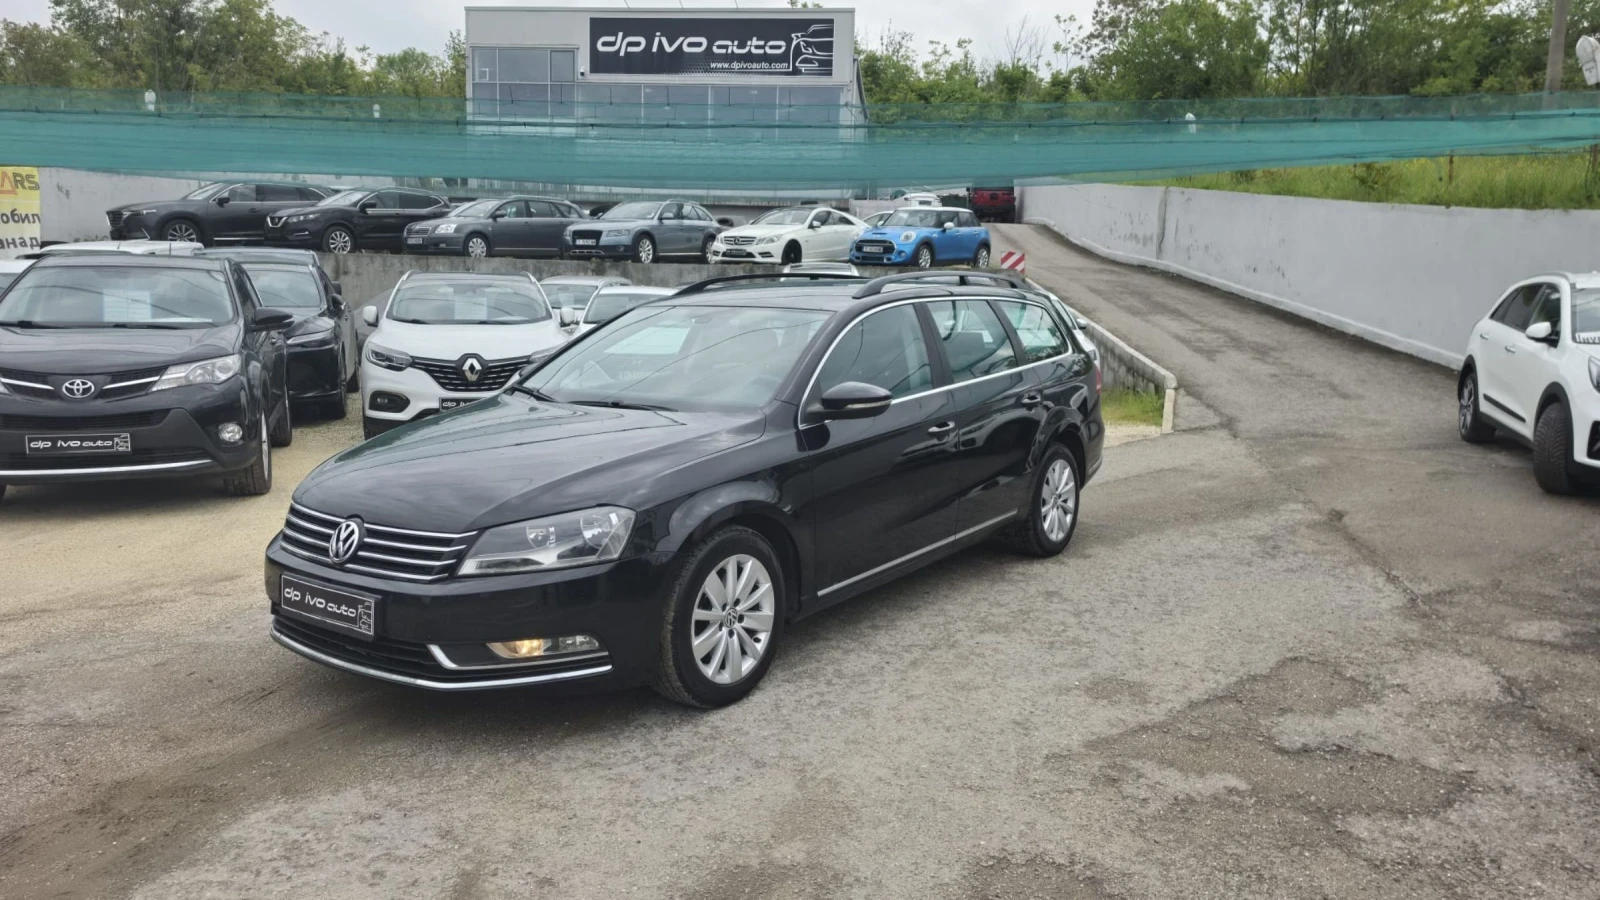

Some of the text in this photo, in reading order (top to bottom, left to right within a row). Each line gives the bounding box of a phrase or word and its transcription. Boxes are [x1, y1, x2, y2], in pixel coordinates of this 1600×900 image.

[597, 32, 786, 56] dp ivo auto
[710, 60, 788, 70] www.dpivoauto.com
[30, 440, 52, 449] dp
[284, 587, 357, 617] dp ivo auto
